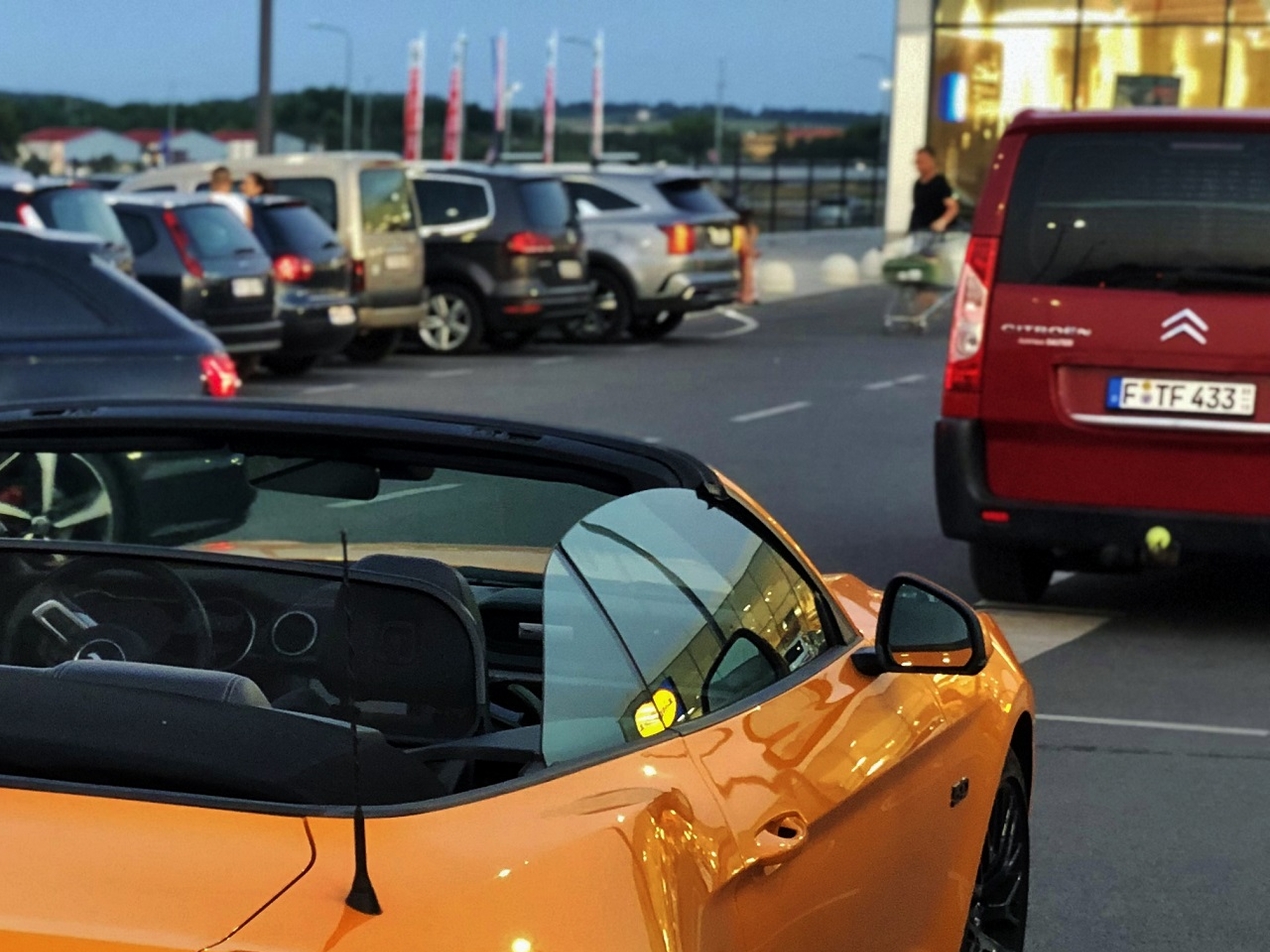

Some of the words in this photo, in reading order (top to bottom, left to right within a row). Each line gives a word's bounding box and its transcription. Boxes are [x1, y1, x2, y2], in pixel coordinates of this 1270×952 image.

[1123, 383, 1138, 404] F
[1156, 384, 1186, 407] TF
[1191, 386, 1236, 410] 433
